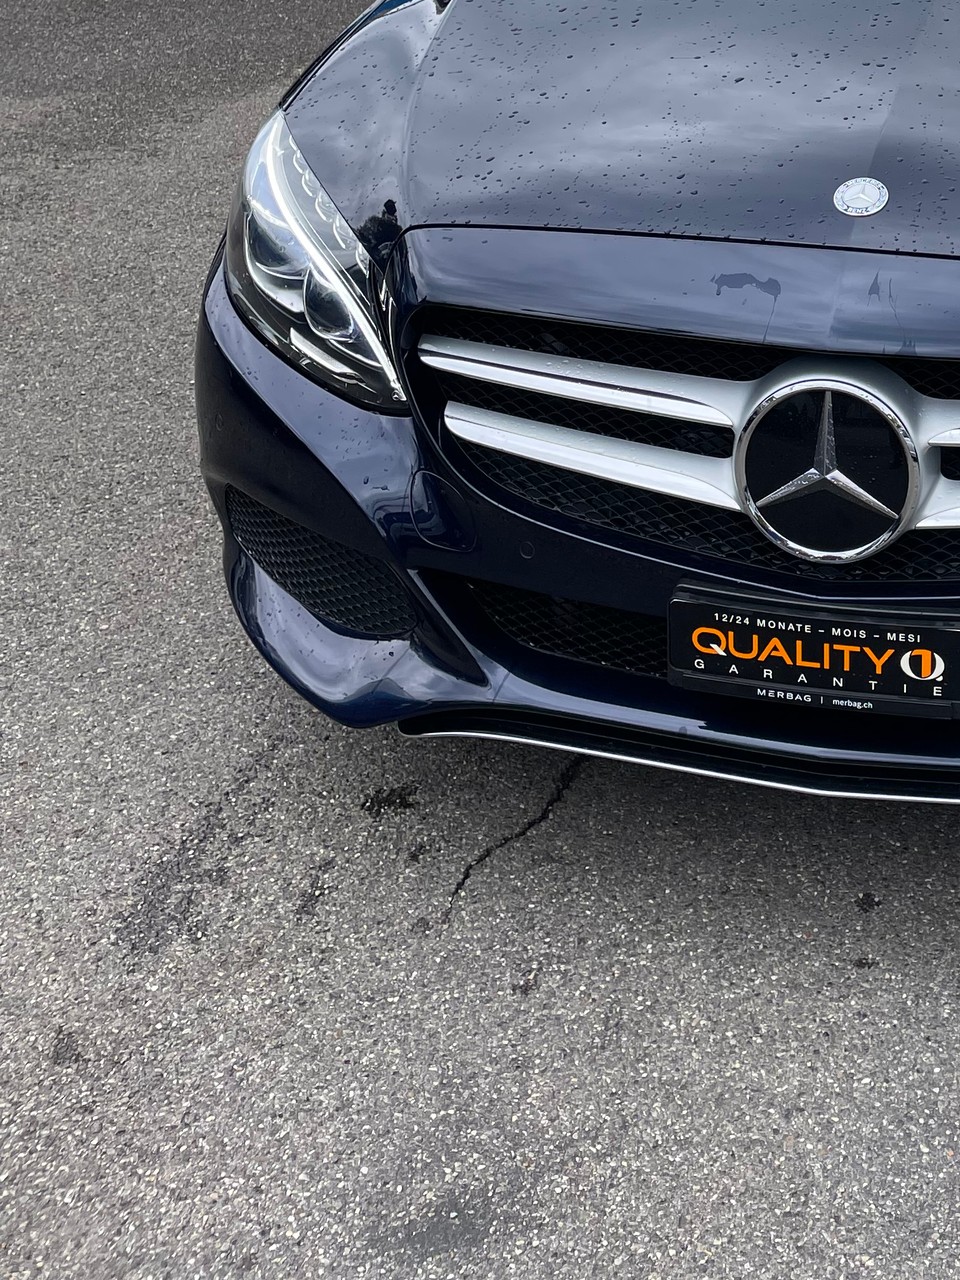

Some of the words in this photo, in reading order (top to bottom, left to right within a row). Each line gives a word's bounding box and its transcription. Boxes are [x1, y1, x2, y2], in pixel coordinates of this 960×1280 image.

[714, 612, 750, 626] 12/24
[756, 619, 812, 633] MONATE
[831, 627, 866, 639] MOIS
[887, 632, 921, 643] MESI
[691, 626, 895, 675] QUALITY
[694, 658, 943, 697] GARANTIE
[757, 688, 812, 702] MERBAG
[832, 697, 873, 710] merbag.ch
